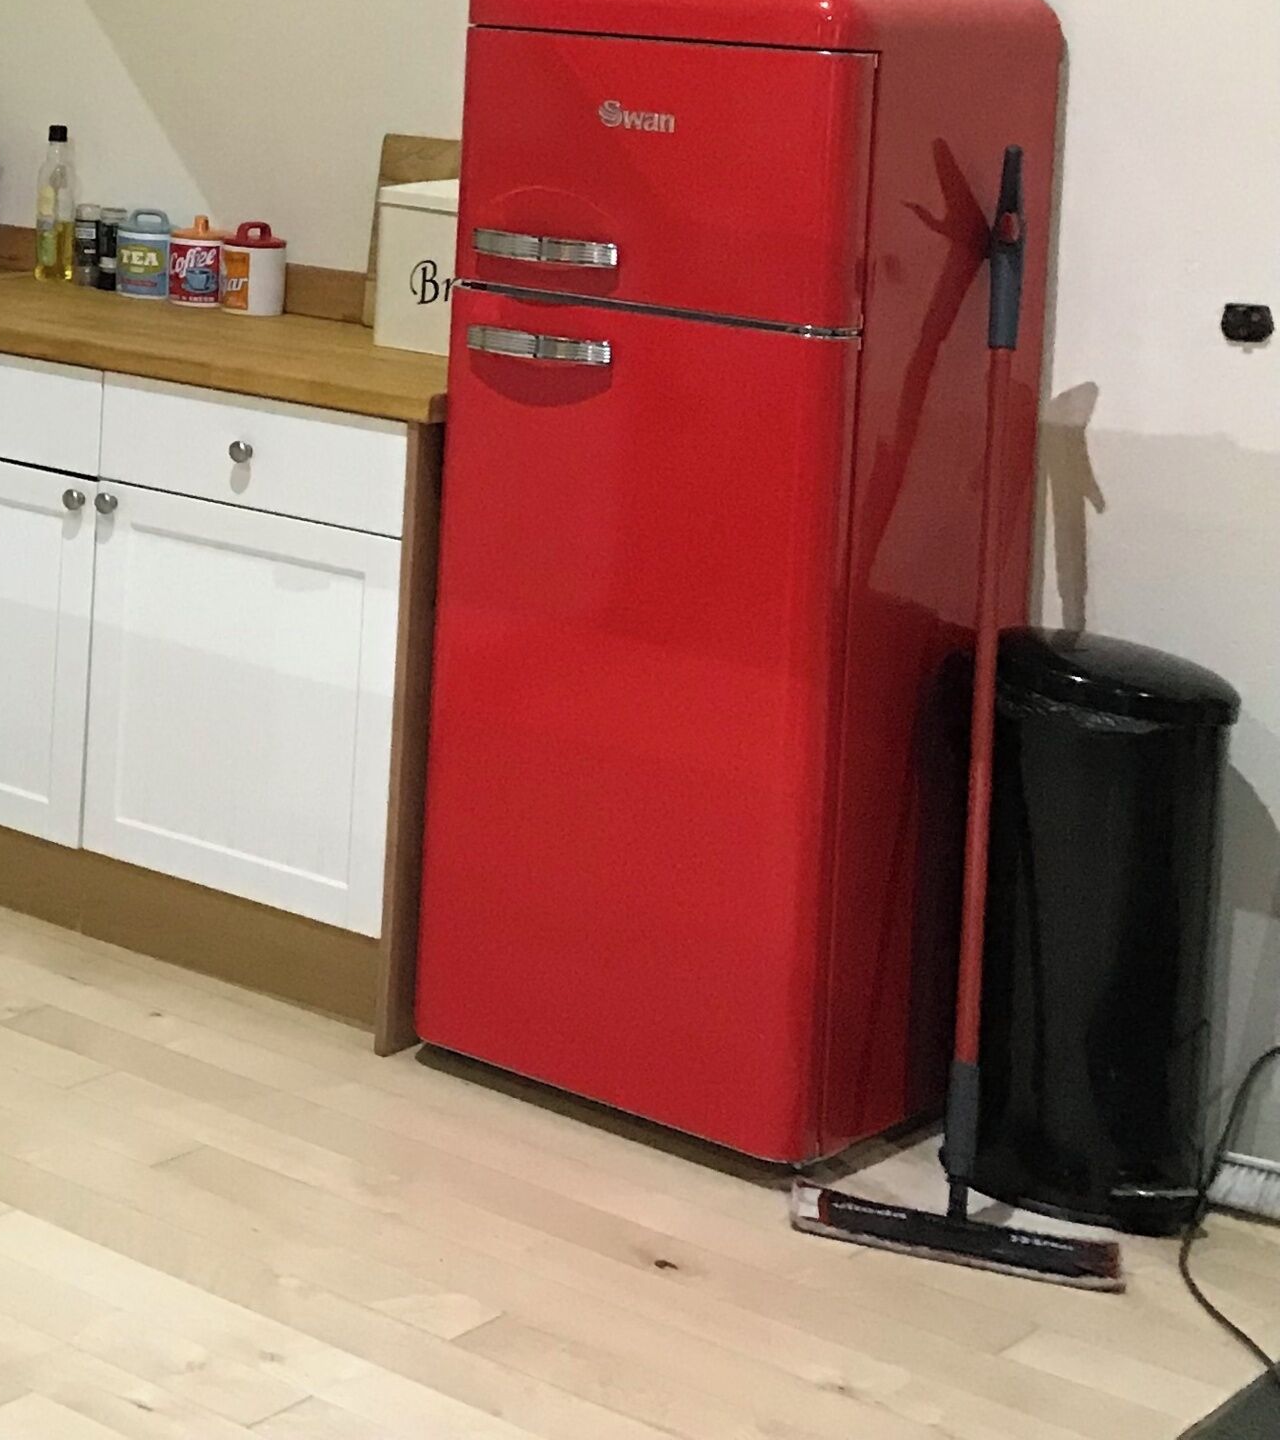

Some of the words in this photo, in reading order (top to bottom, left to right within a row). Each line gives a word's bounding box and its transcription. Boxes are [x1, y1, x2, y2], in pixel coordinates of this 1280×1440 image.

[598, 99, 676, 134] Swan
[120, 248, 159, 267] TEA
[169, 246, 215, 278] Coffee
